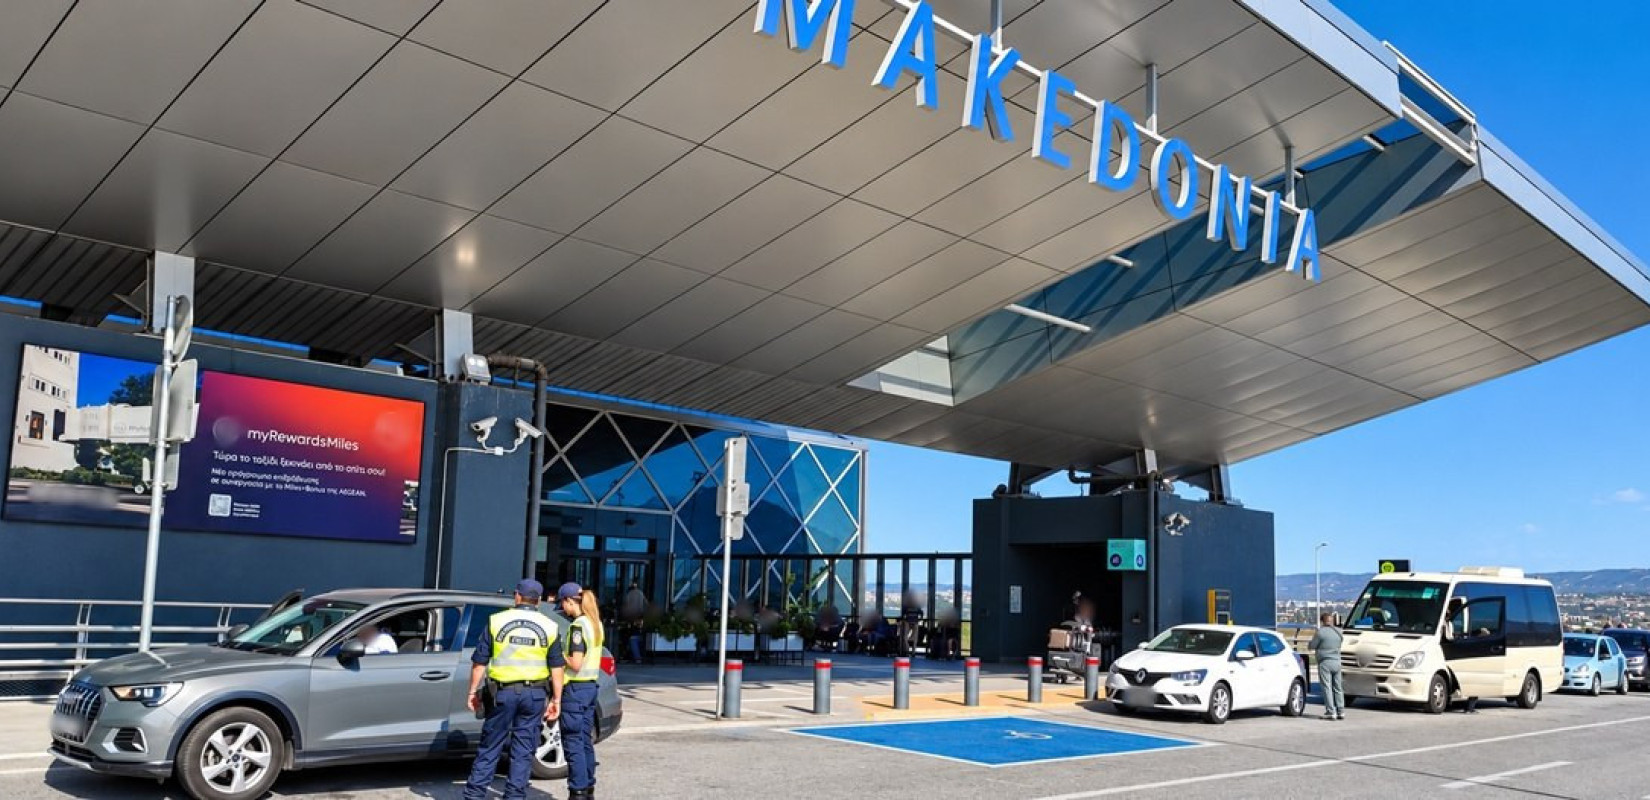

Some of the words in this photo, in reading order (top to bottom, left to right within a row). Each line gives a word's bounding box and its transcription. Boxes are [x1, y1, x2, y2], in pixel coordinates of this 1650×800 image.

[754, 0, 1321, 282] MAKEDONIA
[247, 429, 360, 451] myRewardsMiles
[213, 449, 238, 462] Τώρα
[240, 455, 251, 463] το
[252, 455, 279, 466] ταξίδι
[280, 457, 314, 469] ξεκινάει
[315, 461, 333, 471] από
[335, 464, 345, 472] το
[346, 464, 366, 474] σπίτι
